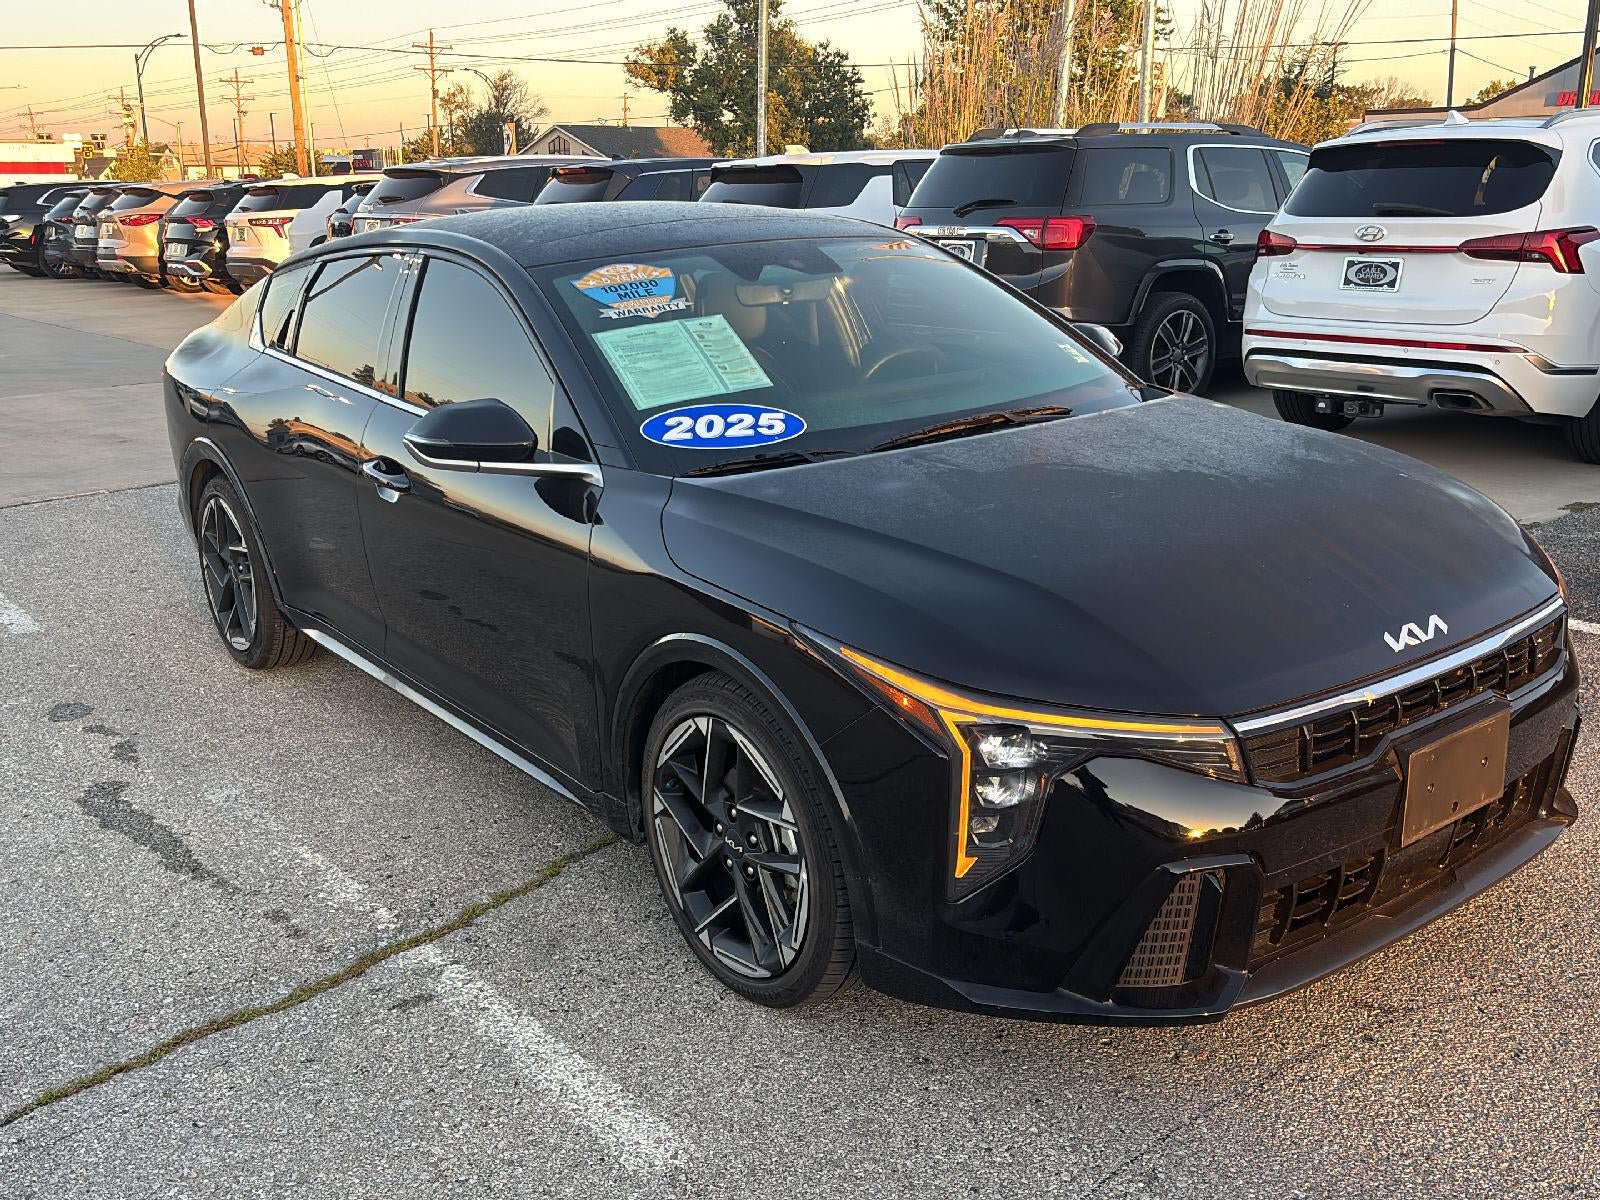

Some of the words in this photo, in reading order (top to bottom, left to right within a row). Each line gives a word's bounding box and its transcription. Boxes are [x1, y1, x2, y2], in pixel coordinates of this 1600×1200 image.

[937, 226, 965, 236] GMC
[613, 272, 648, 284] YEAR
[1356, 272, 1385, 280] DAHMER
[617, 288, 657, 301] MILE
[613, 302, 681, 318] WARRANTY
[661, 412, 786, 442] 2025
[1383, 614, 1449, 653] KIA
